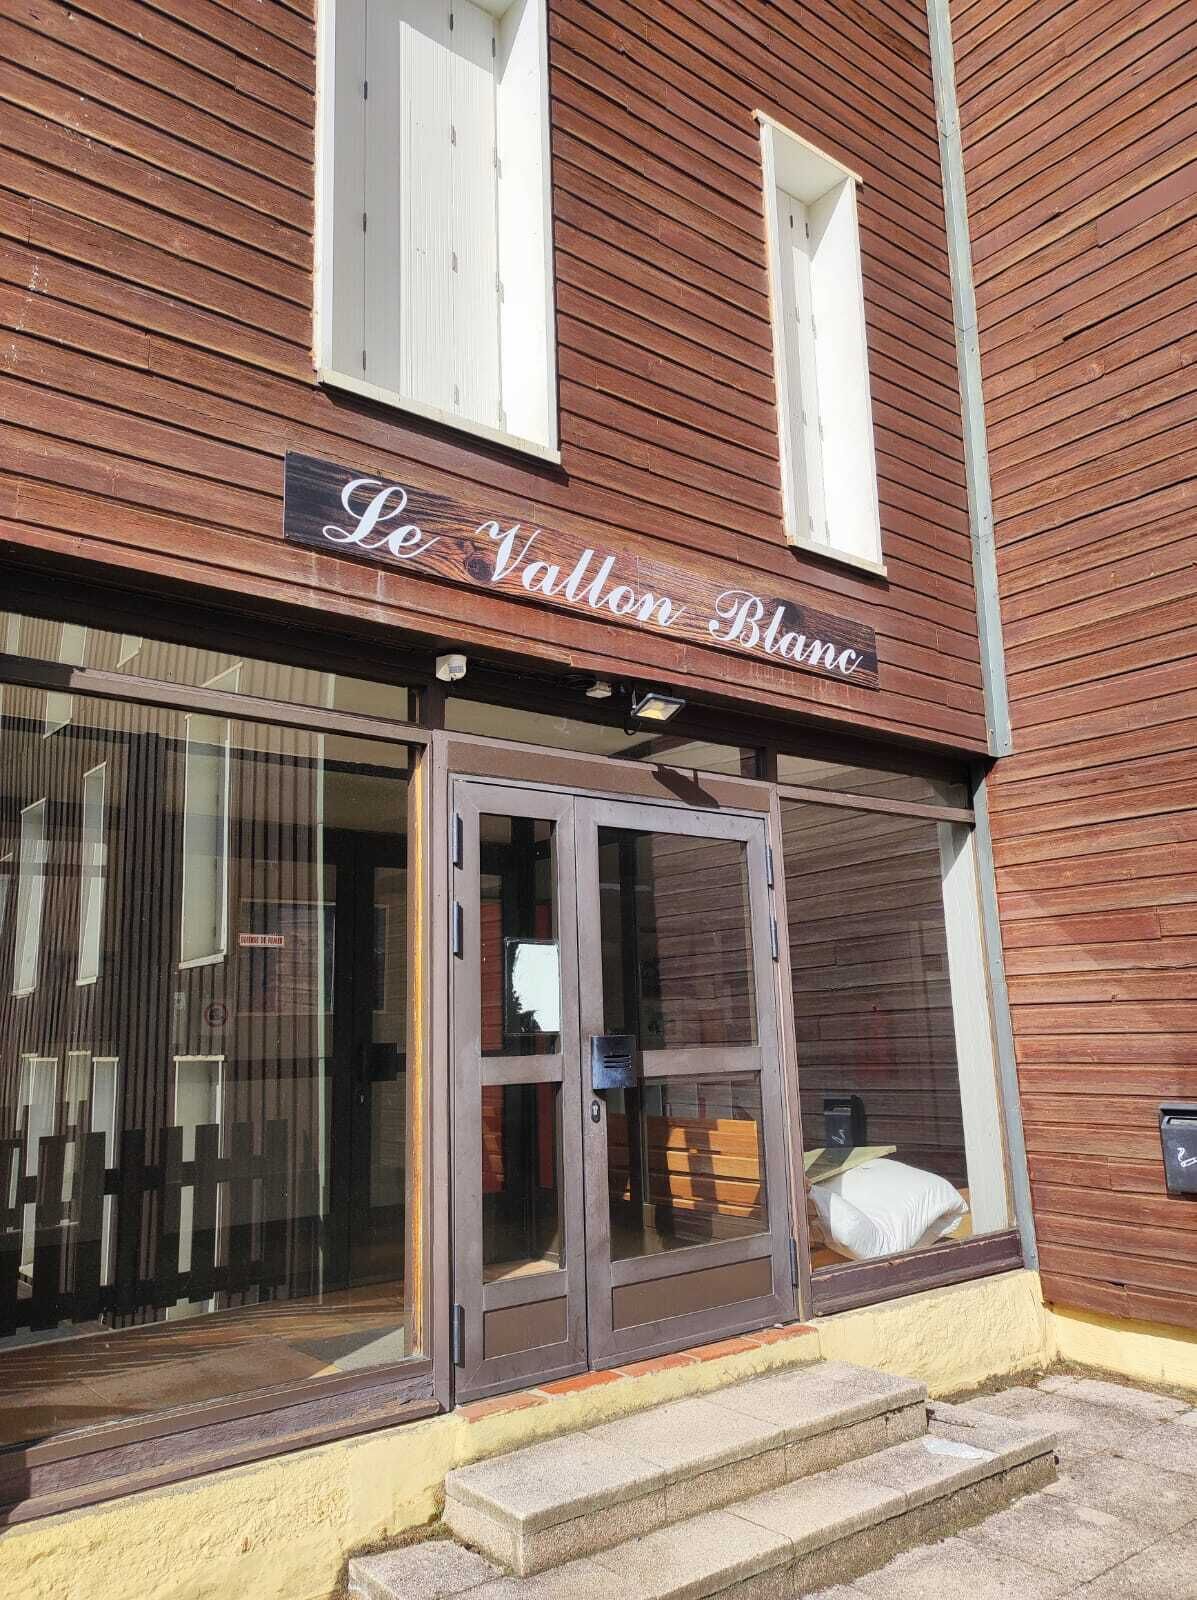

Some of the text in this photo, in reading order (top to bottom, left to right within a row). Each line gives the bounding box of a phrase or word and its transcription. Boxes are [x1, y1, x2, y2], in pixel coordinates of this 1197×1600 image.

[322, 478, 863, 675] Le Vallon Blanc
